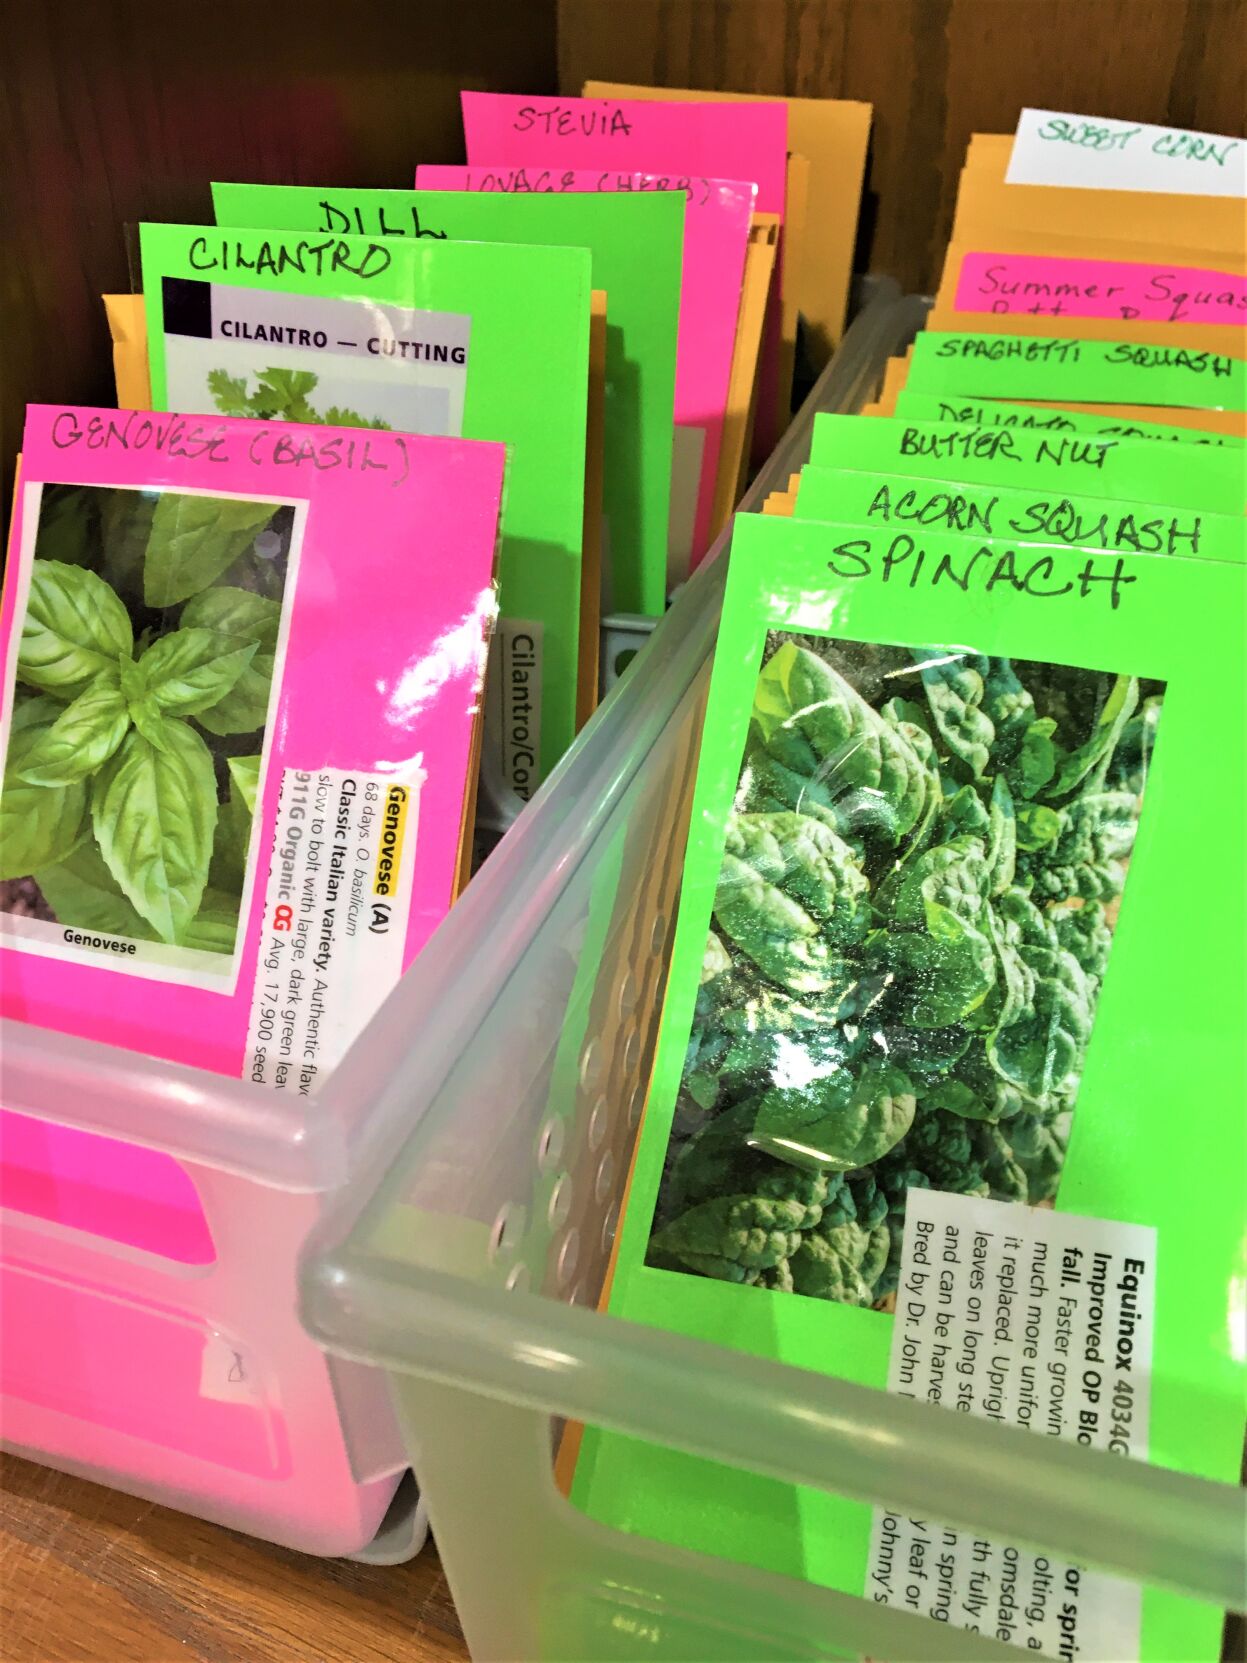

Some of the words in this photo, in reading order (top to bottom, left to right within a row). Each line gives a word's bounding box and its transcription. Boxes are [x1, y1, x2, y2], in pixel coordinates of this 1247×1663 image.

[1151, 133, 1239, 167] CORN
[318, 200, 448, 240] DILL
[188, 237, 392, 279] CILANTRO
[978, 265, 1125, 298] Summer
[1144, 274, 1247, 322] Squas
[220, 319, 329, 349] CILANTRO
[366, 336, 466, 364] CUTTING
[935, 338, 1081, 364] SPAGHETTI
[1103, 344, 1232, 378] SQUASH
[51, 410, 229, 464] GENOVESE
[249, 430, 410, 488] (BASIL)
[899, 425, 1023, 462] BUTTER
[1036, 438, 1120, 469] NUT
[868, 484, 1000, 535] ACORN
[1008, 498, 1202, 555] SQUASH
[827, 533, 1138, 611] SPINACH
[510, 634, 536, 803] Cilantro/Cor
[289, 771, 312, 820] 911G
[314, 774, 333, 813] slow
[334, 779, 357, 840] Classic
[364, 782, 379, 801] 68
[311, 819, 327, 835] to
[357, 806, 376, 842] days.
[376, 786, 407, 896] Genovese
[277, 826, 303, 900] Organic
[305, 840, 325, 872] bolt
[325, 845, 348, 902] Italian
[273, 904, 294, 932] OG
[299, 878, 317, 913] with
[346, 868, 368, 937] basilicum
[291, 919, 313, 962] large,
[313, 908, 337, 973] variety.
[368, 903, 392, 934] (A)
[63, 929, 137, 955] Genovese
[264, 937, 285, 973] Avg.
[287, 969, 306, 1005] dark
[257, 983, 280, 1041] 17,900
[281, 1009, 297, 1056] green
[303, 979, 328, 1059] Authentic
[275, 1061, 293, 1089] lea
[298, 1064, 318, 1097] flav
[913, 1221, 935, 1266] Bred
[939, 1224, 961, 1264] and
[967, 1230, 994, 1291] leaves
[1004, 1235, 1024, 1251] it
[904, 1271, 930, 1296] by
[937, 1270, 954, 1308] can
[1030, 1241, 1049, 1298] much
[1060, 1247, 1084, 1288] fall.
[903, 1302, 926, 1327] Dr.
[966, 1295, 983, 1323] on
[993, 1257, 1019, 1347] replaced.
[1084, 1252, 1113, 1364] Improved
[1115, 1258, 1146, 1373] Equinox
[934, 1313, 956, 1338] be
[1023, 1307, 1042, 1359] more
[1054, 1296, 1078, 1357] Faster
[899, 1334, 922, 1384] John
[956, 1328, 984, 1376] long
[956, 1382, 975, 1414] ste
[1017, 1366, 1041, 1430] unifor
[1047, 1363, 1069, 1437] growin
[1081, 1370, 1102, 1404] OP
[1077, 1410, 1099, 1447] Blo
[1108, 1378, 1135, 1457] 4034G
[908, 1537, 932, 1581] leaf
[905, 1584, 921, 1609] or
[929, 1553, 958, 1623] spring
[962, 1571, 991, 1618] fully
[995, 1547, 1020, 1642] omsdale
[1025, 1557, 1054, 1627] olting,
